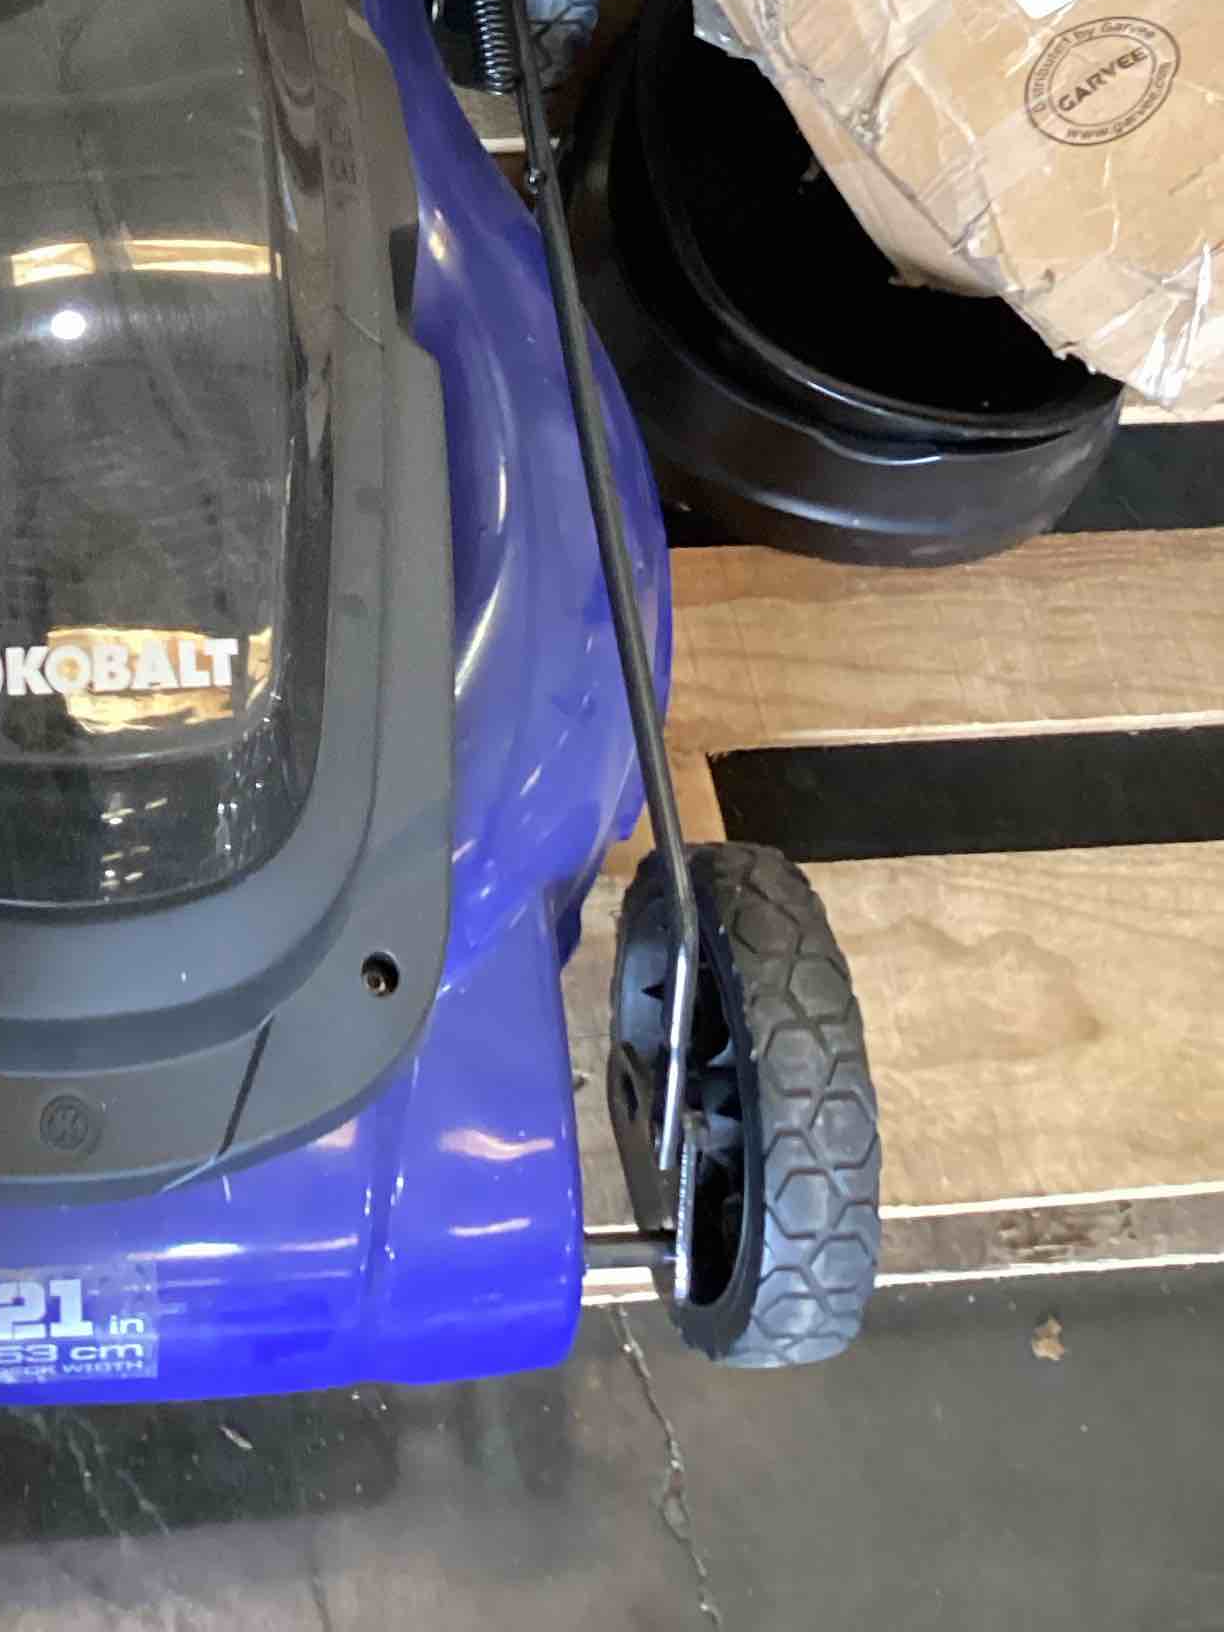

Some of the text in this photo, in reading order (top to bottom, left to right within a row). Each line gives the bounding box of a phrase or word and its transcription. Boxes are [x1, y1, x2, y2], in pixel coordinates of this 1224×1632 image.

[1058, 44, 1148, 114] GARVEE
[6, 637, 239, 696] KOBALT
[108, 1314, 145, 1337] in
[69, 1342, 145, 1360] cm
